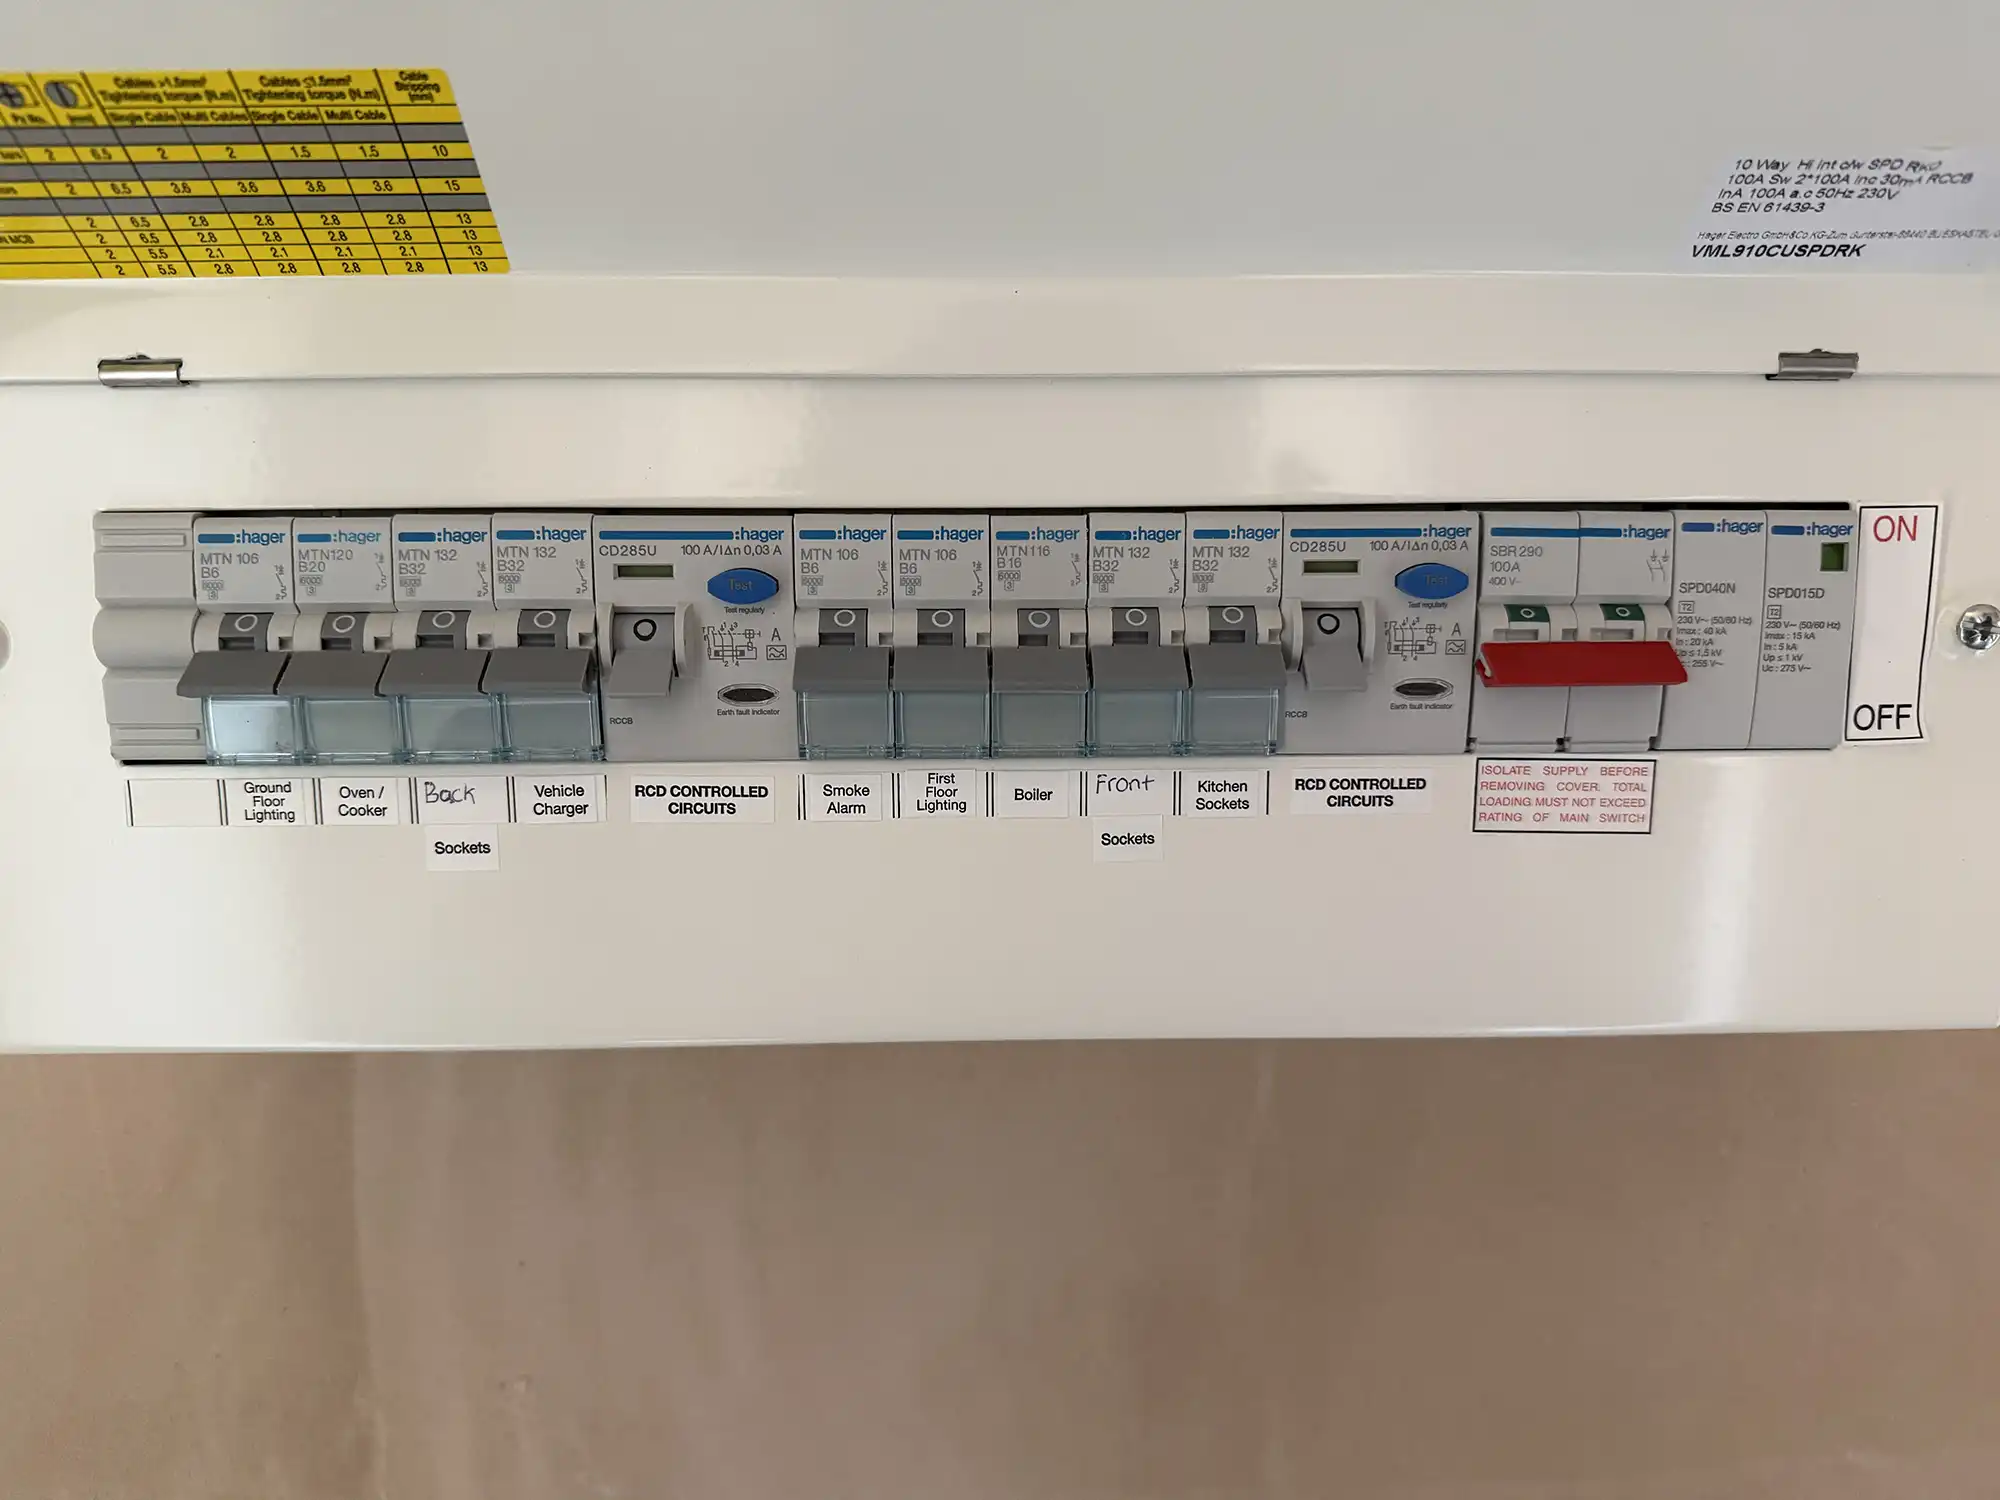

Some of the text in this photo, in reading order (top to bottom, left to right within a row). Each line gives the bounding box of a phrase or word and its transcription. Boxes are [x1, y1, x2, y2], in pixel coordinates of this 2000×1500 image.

[290, 144, 448, 159] 1.5 1.5 10
[1735, 159, 1753, 170] 10
[1755, 159, 1790, 172] Way
[1867, 158, 1903, 171] SPD
[1727, 173, 1764, 185] 100A
[1768, 173, 1791, 185] Sw
[1926, 172, 1973, 185] RCCB
[305, 179, 460, 193] 3.6 3.6 15
[1749, 188, 1785, 199] 100A
[1815, 188, 1854, 199] 50Hz
[1856, 188, 1900, 200] 230V
[1711, 202, 1826, 214] BS EN 61439-3
[320, 213, 472, 226] 2.8 2.8 13
[327, 230, 478, 242] 2.8 2.8 13
[334, 245, 483, 258] 2.1 2.1 13
[1691, 243, 1866, 258] VML910CUSPDRK
[341, 261, 488, 274] 2.8 2.8 13
[1873, 515, 1918, 542] ON
[496, 546, 557, 559] MTN 132
[599, 544, 657, 557] CD285U
[680, 544, 700, 556] 100
[772, 545, 783, 556] A
[1093, 546, 1151, 559] MTN 132
[1192, 545, 1250, 558] MTN 132
[1289, 541, 1346, 553] CD285U
[1369, 540, 1389, 551] 100
[1459, 540, 1469, 551] A
[200, 552, 260, 565] MTN 106
[399, 549, 457, 562] MTN 132
[800, 548, 859, 561] MTN 106
[899, 549, 957, 561] MTN 106
[298, 561, 326, 573] B20
[399, 562, 427, 575] B32
[497, 560, 525, 572] B32
[801, 562, 819, 574] B6
[899, 562, 918, 575] B6
[996, 557, 1022, 569] B16
[1093, 559, 1119, 572] B32
[1192, 559, 1219, 572] B32
[1490, 561, 1521, 573] 100A
[201, 567, 220, 579] B6
[728, 578, 753, 591] Test
[1678, 582, 1736, 594] SPD040N
[1767, 587, 1825, 599] SPD015D
[1677, 616, 1693, 624] 230
[1765, 621, 1781, 629] 230
[717, 708, 780, 716] Earth fault indicator
[1853, 704, 1912, 731] OFF
[609, 717, 633, 725] RCCB
[1481, 765, 1648, 777] ISOLATE SUPPLY BEFORE
[927, 773, 956, 785] First
[1095, 774, 1156, 794] Front
[1294, 778, 1426, 791] RCD CONTROLLED
[243, 781, 292, 795] Ground
[338, 785, 375, 800] Oven
[533, 784, 585, 799] Vehicle
[634, 785, 769, 799] RCD CONTROLLED
[822, 784, 871, 798] Smoke
[925, 785, 958, 799] Floor
[1198, 779, 1248, 793] Kitchen
[1480, 781, 1545, 791] REMOVING
[1612, 782, 1647, 792] TOTAL
[424, 781, 477, 806] Back
[1013, 787, 1053, 802] Boiler
[252, 795, 285, 808] Floor
[667, 801, 737, 815] CIRCUITS
[827, 801, 866, 815] Alarm
[916, 798, 968, 814] Lighting
[1195, 797, 1250, 811] Sockets
[1326, 795, 1394, 808] CIRCUITS
[1535, 797, 1568, 807] MUST
[1571, 797, 1596, 807] NOT
[1599, 798, 1646, 808] EXCEED
[243, 808, 296, 823] Lighting
[338, 803, 387, 818] Cooker
[533, 801, 589, 818] Charger
[1478, 812, 1645, 823] RATING OF MAIN SWITCH
[1101, 833, 1155, 846] Sockets
[434, 840, 491, 855] Sockets
